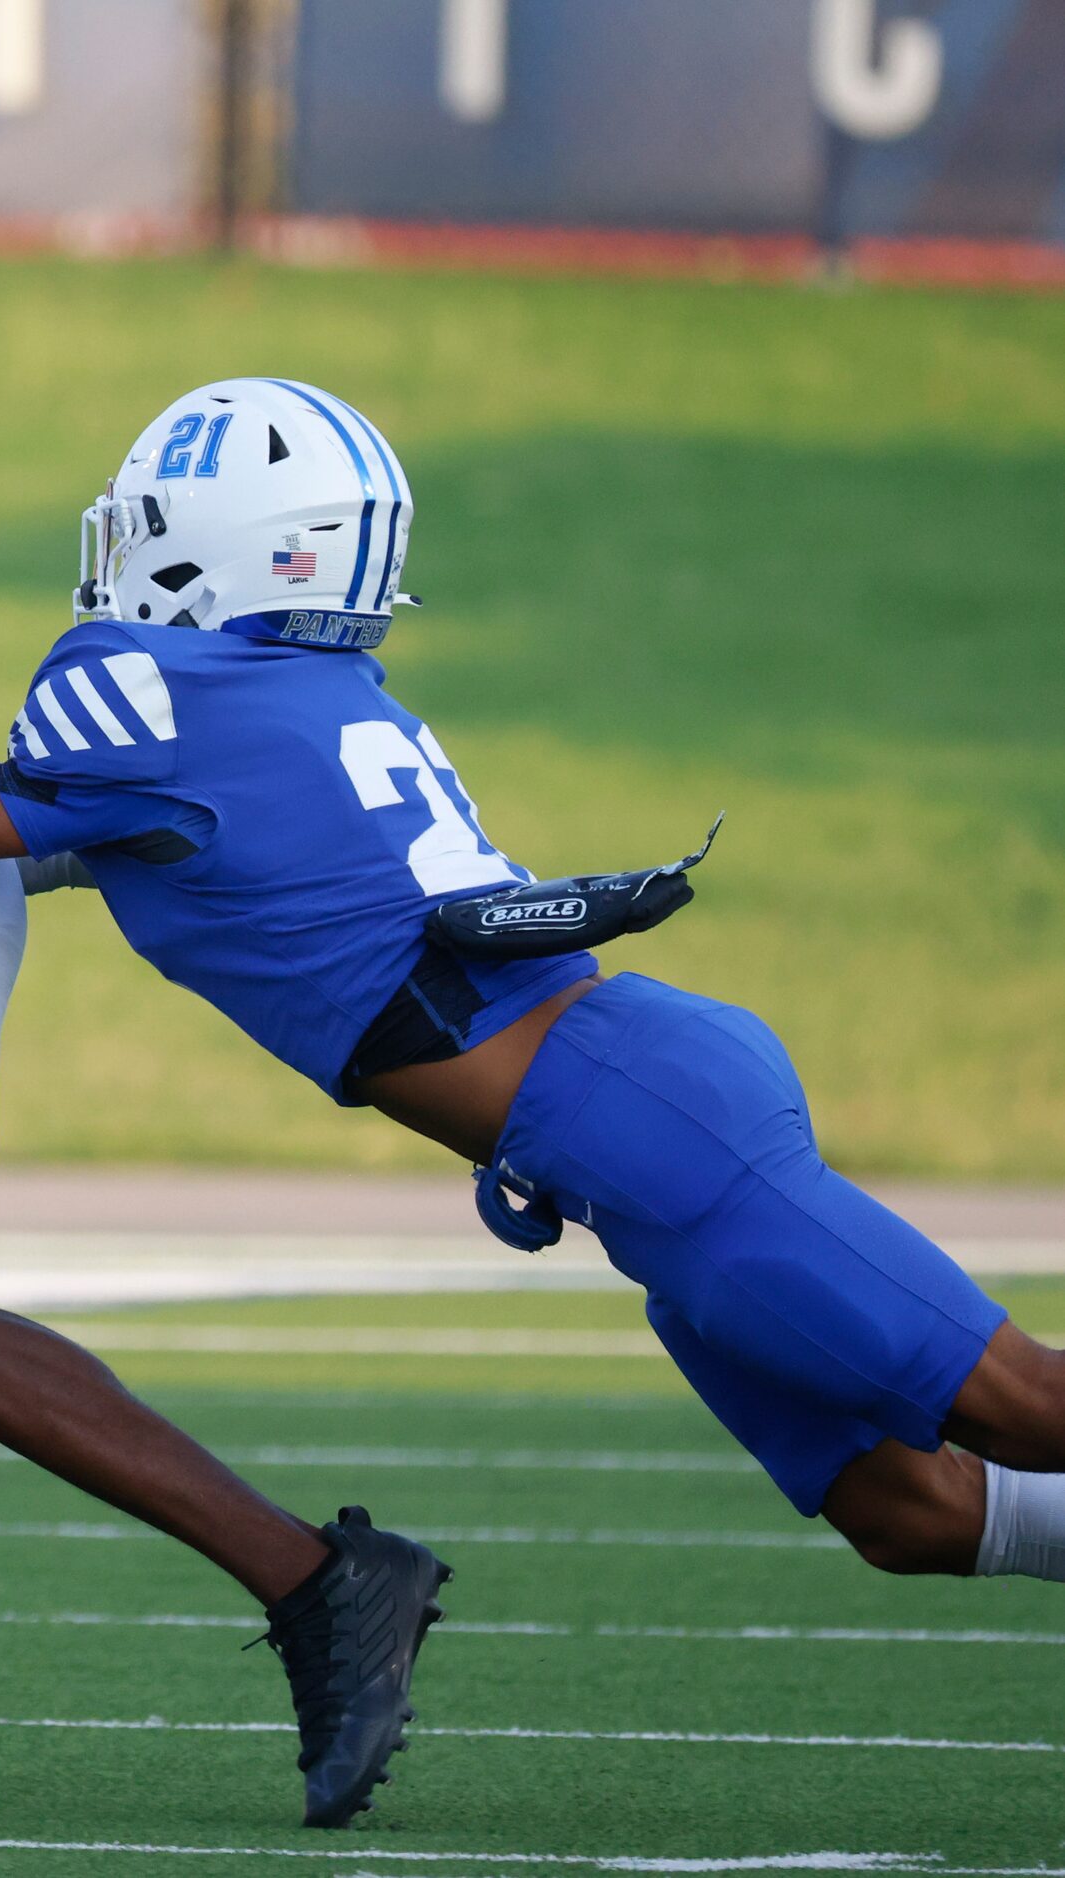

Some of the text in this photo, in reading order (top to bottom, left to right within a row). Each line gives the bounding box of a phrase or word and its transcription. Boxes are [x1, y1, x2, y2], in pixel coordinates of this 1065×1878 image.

[156, 413, 234, 480] 21
[280, 610, 391, 647] PANTHE
[491, 901, 576, 922] BATTLE
